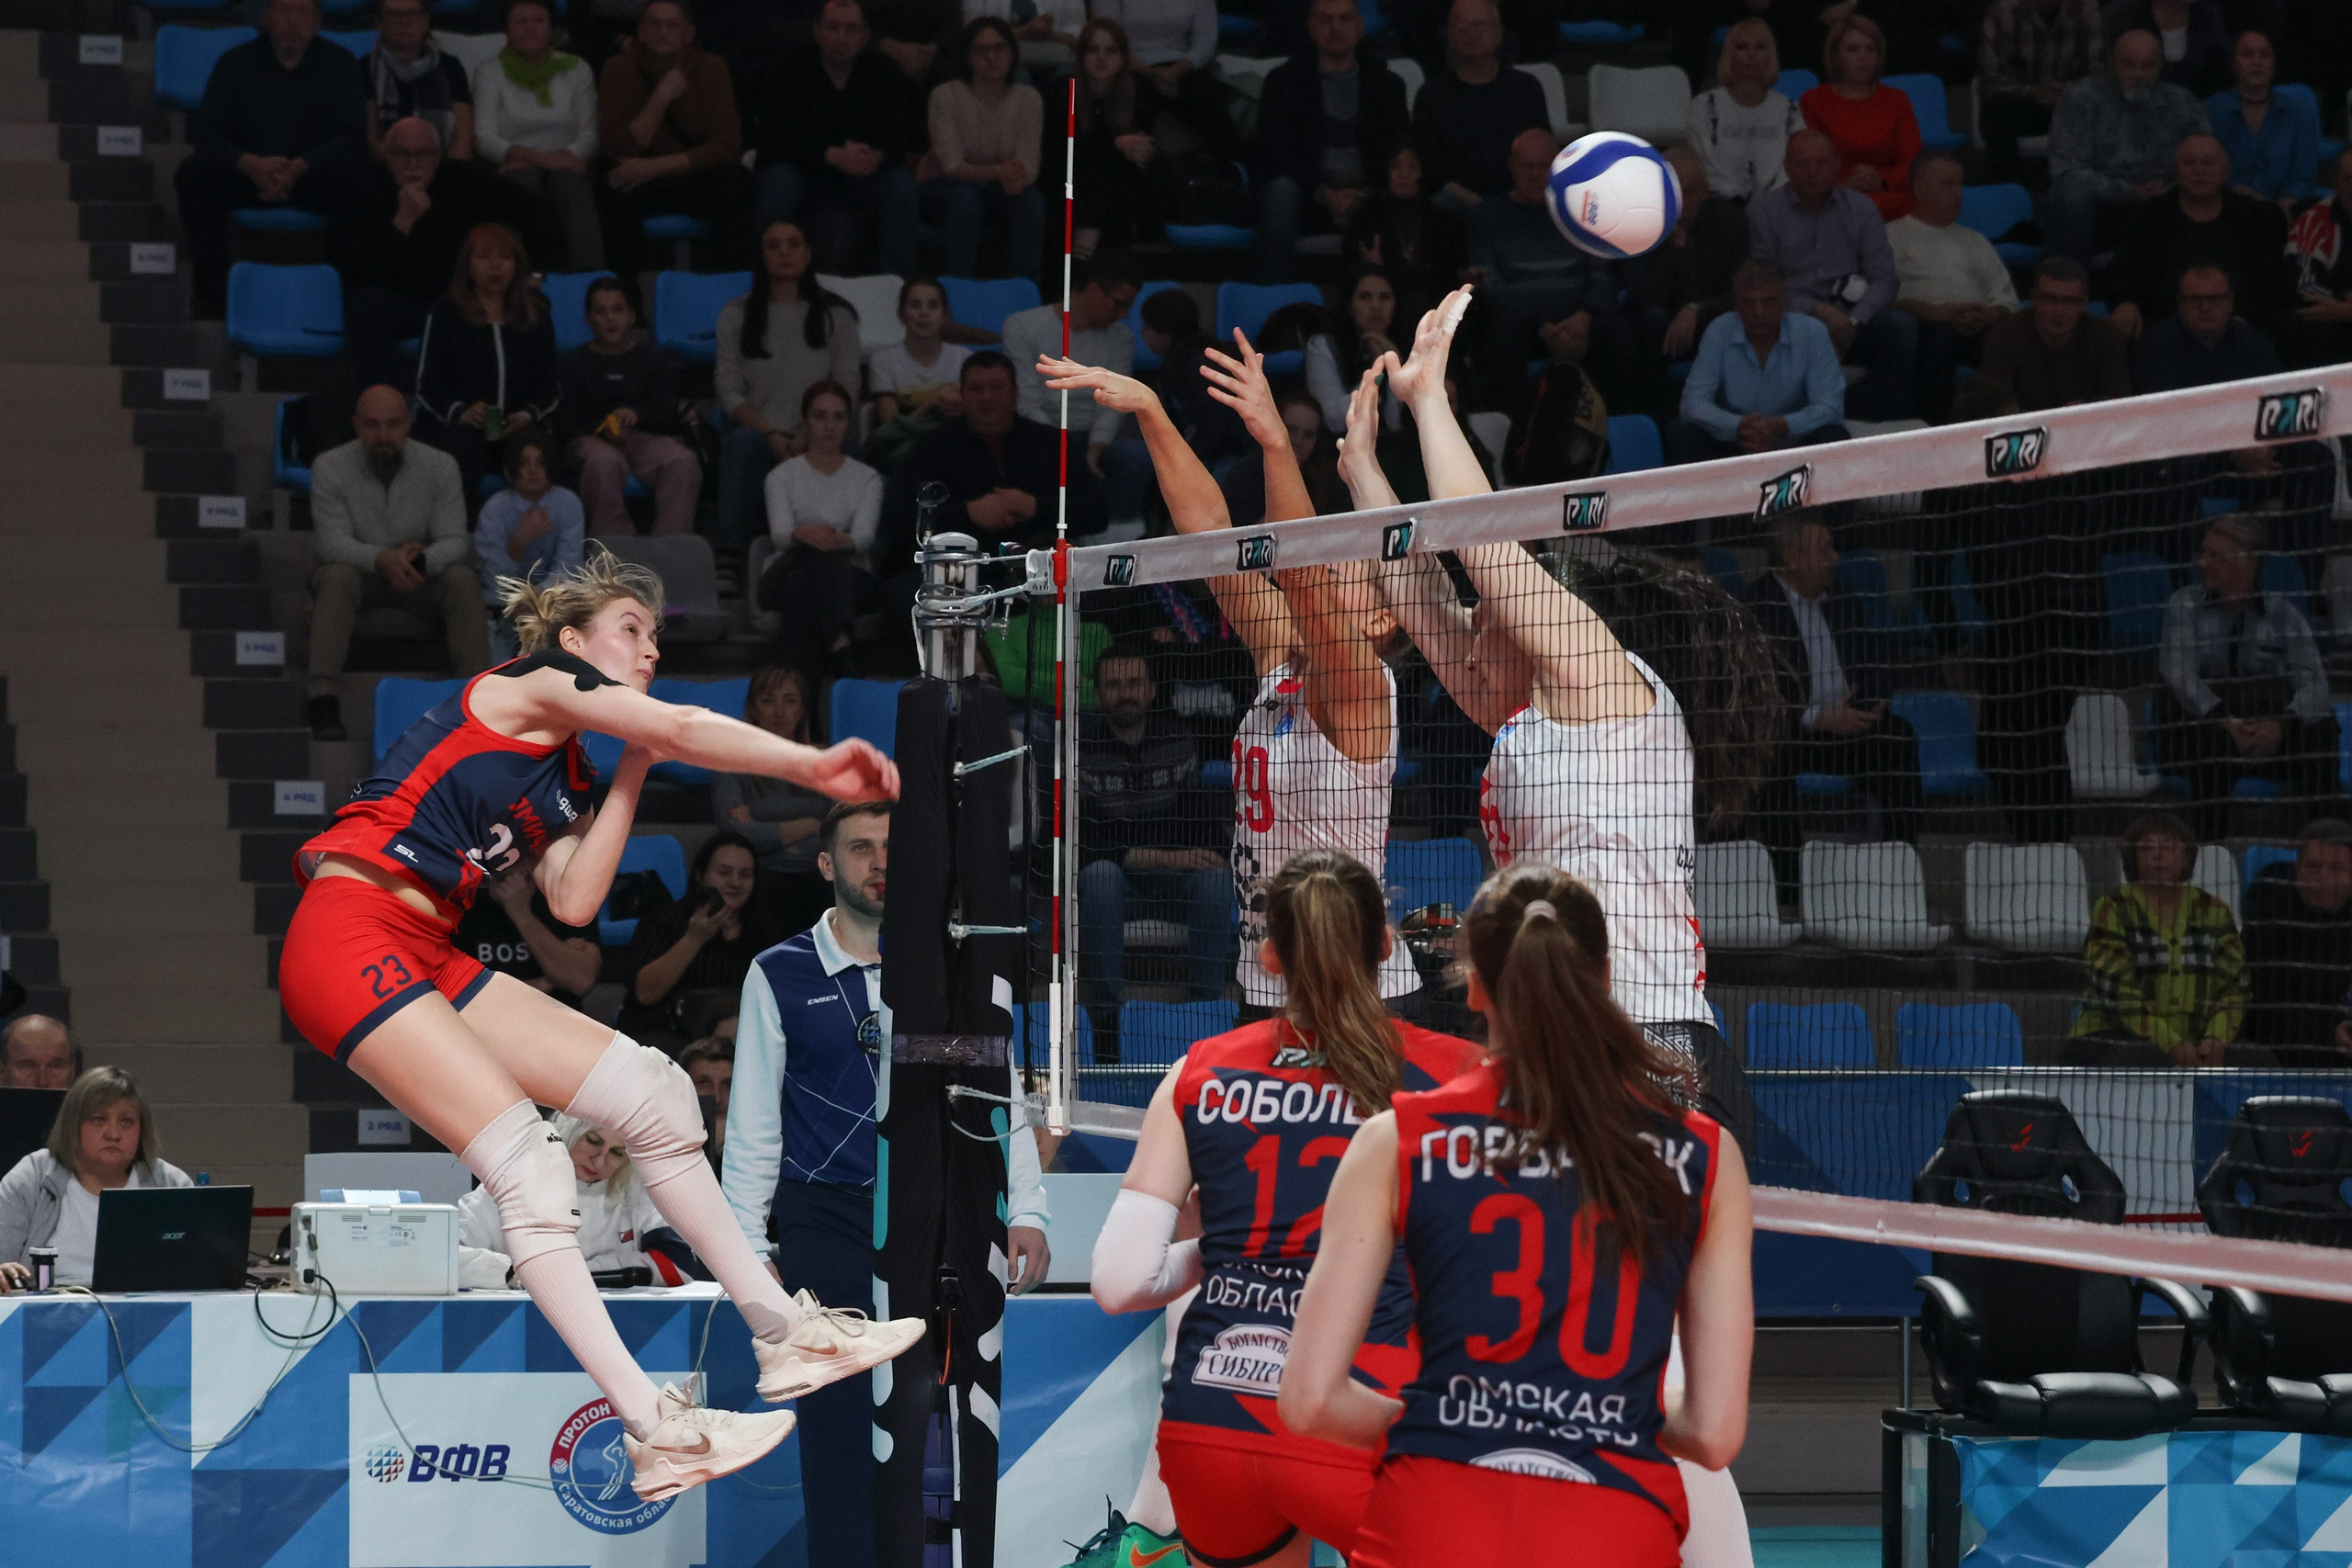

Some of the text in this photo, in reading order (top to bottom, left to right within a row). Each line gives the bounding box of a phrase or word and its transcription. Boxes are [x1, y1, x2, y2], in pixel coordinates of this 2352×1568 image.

[2261, 393, 2319, 434] PARI
[1992, 432, 2042, 472] PARI
[1566, 496, 1605, 525] PARI
[1761, 469, 1806, 515] PARI
[1109, 558, 1133, 581] PAR
[394, 843, 419, 863] SL
[478, 942, 530, 963] BOS
[360, 954, 412, 1000] 23
[807, 994, 839, 1006] ENSEN
[368, 1122, 401, 1132] 2 РЯД
[1241, 1134, 1351, 1258] 12
[162, 1232, 186, 1240] acer
[1465, 1192, 1641, 1381] 30
[1209, 1353, 1283, 1384] СИБИР
[558, 1402, 612, 1450] ПРОТОН
[407, 1443, 511, 1483] ВФВ
[559, 1483, 671, 1529] Саратовская обла
